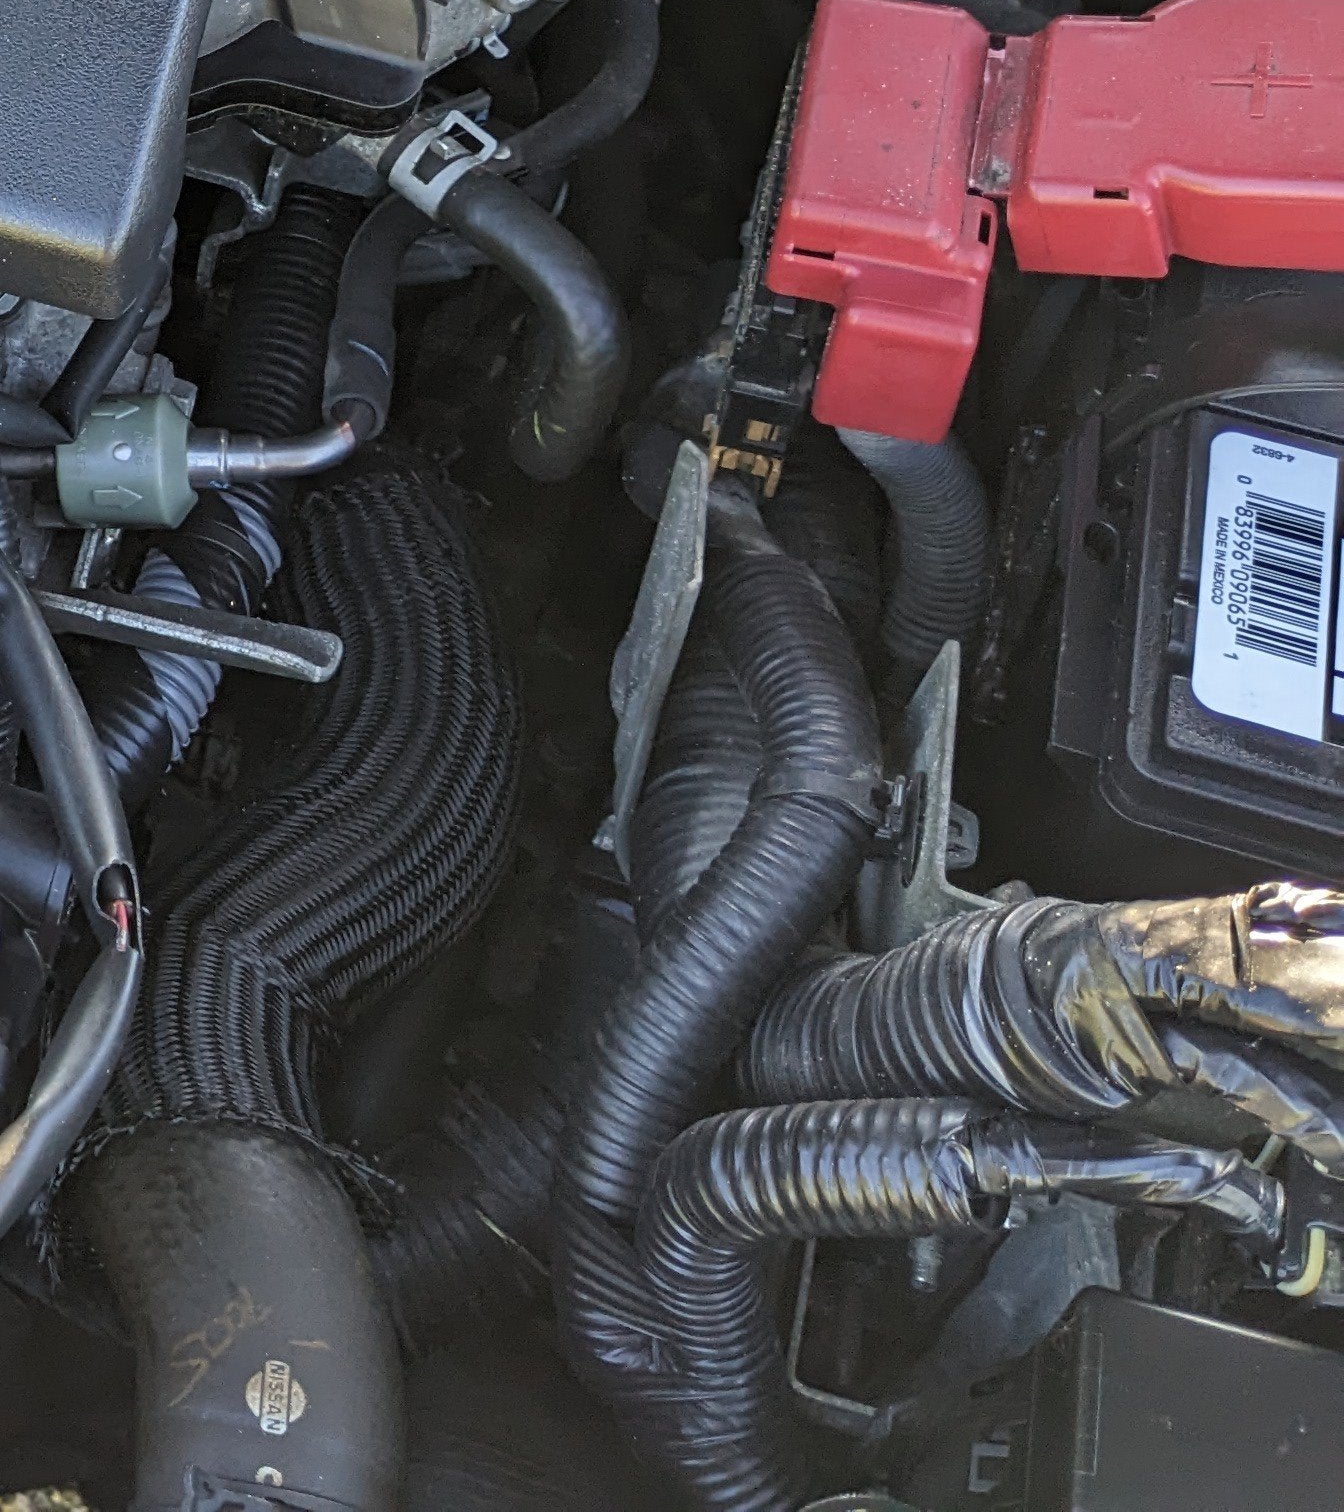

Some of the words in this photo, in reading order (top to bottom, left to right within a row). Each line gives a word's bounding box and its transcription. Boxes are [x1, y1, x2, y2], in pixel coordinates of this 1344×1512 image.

[1237, 475, 1252, 485] 0
[1215, 516, 1229, 548] MADE
[1232, 506, 1254, 561] 83996
[1214, 549, 1226, 561] IN
[1211, 561, 1226, 605] MEXICO
[1227, 569, 1250, 628] 09065
[1223, 653, 1239, 661] 1
[266, 1362, 286, 1431] NISSAN
